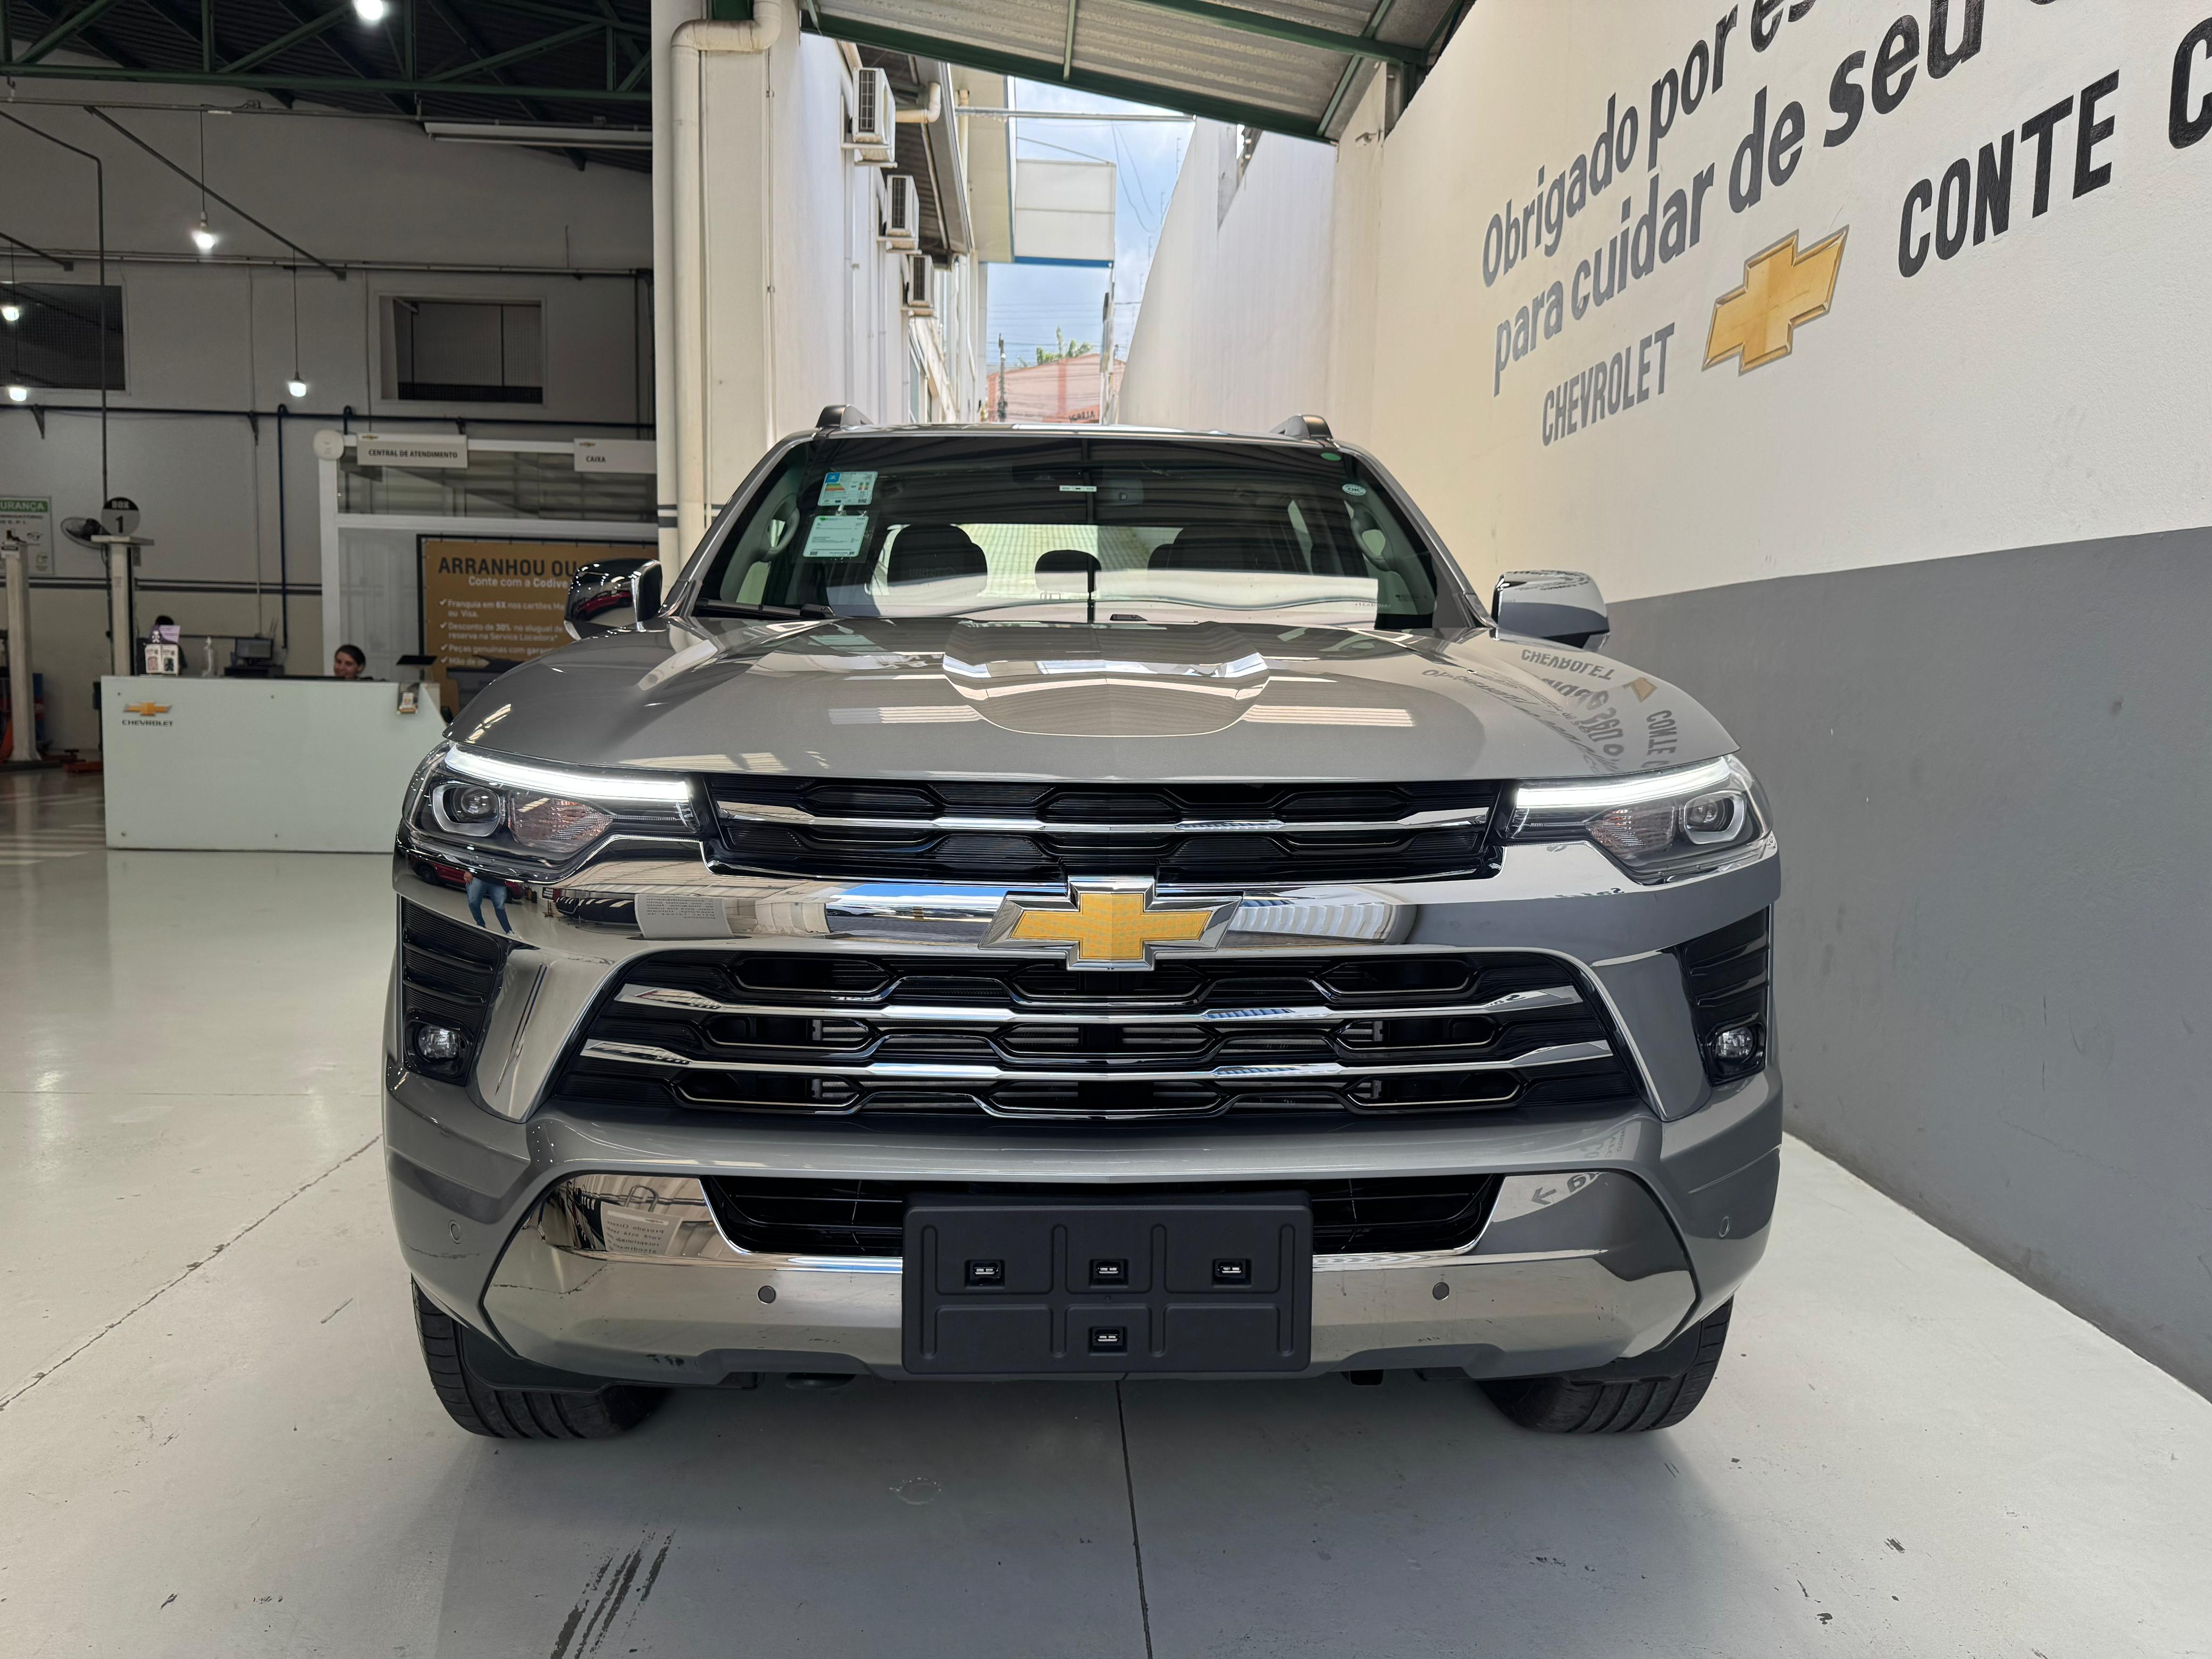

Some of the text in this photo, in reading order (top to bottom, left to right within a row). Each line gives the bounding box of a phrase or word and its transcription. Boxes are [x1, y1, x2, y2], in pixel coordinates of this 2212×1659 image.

[1482, 91, 1638, 288] Obrigado
[1647, 3, 1739, 172] por
[1898, 69, 2119, 278] CONTE
[1494, 0, 1985, 398] para cuidar de seu
[1541, 322, 1675, 447] CHEVROLET
[368, 448, 398, 457] CENTRAL
[409, 450, 458, 458] ATENDIMENTO
[115, 515, 123, 533] 1
[439, 557, 577, 576] ARRANHOU OU
[468, 575, 498, 586] Conte
[500, 579, 523, 587] com
